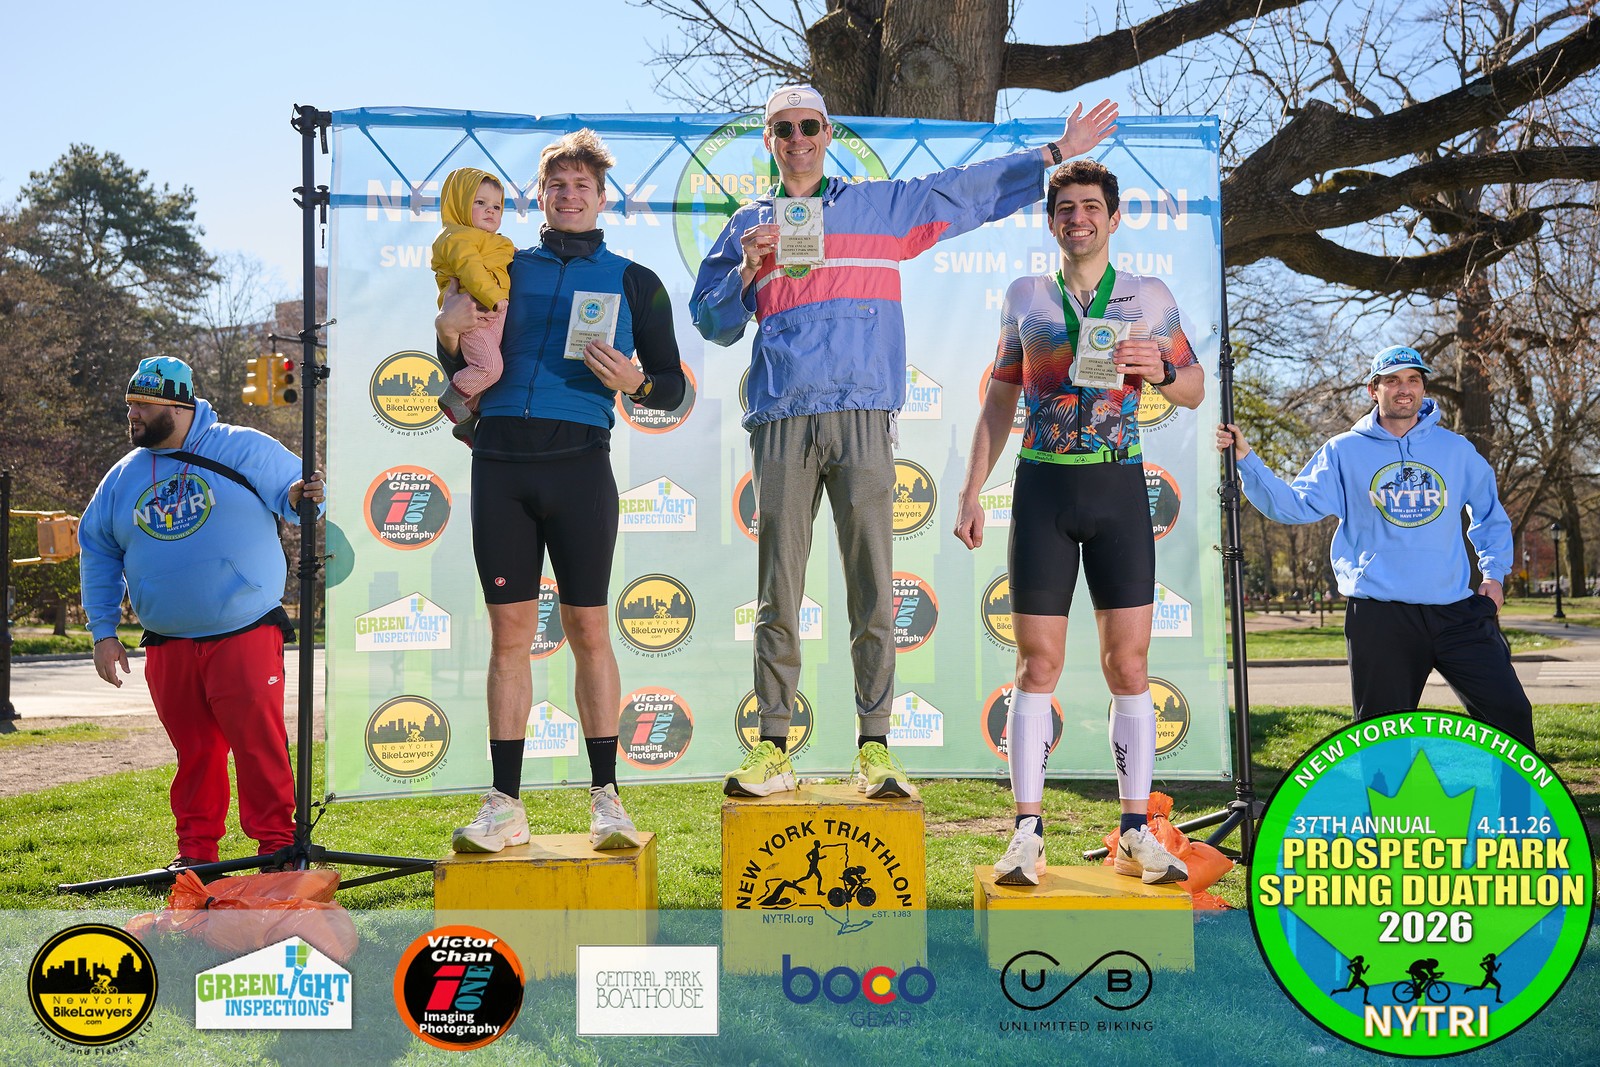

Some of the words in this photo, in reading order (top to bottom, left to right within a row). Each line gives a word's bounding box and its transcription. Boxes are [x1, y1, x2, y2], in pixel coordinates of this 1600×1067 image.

[704, 126, 737, 156] NEW
[366, 179, 440, 222] NE
[934, 251, 1006, 273] SWIM
[1117, 252, 1173, 275] RUN
[386, 404, 438, 412] BikeLawyers
[633, 408, 665, 416] Imaging
[630, 416, 681, 424] Photography
[1170, 411, 1179, 422] LLP
[386, 472, 434, 480] Victor
[389, 481, 430, 490] Chan
[1368, 489, 1448, 507] NYTRI
[133, 488, 216, 526] NYTRI
[619, 498, 694, 516] REENLIGHT
[384, 523, 418, 532] Imaging
[925, 519, 935, 530] LLP
[380, 531, 435, 540] Photography
[893, 587, 918, 596] han
[631, 626, 680, 634] BikeLawyers
[683, 634, 693, 646] LLP
[632, 693, 677, 702] Victor
[634, 703, 673, 711] Chan
[630, 743, 663, 752] Imaging
[801, 743, 811, 754] LLP
[1179, 739, 1189, 750] LLP
[381, 751, 434, 759] BikeLawyers
[627, 750, 679, 760] Photography
[438, 758, 448, 770] LLP
[736, 859, 762, 910] NEW
[758, 819, 817, 857] YORK
[823, 819, 912, 907] TRIATHLON
[762, 913, 814, 926] NYTRI.org
